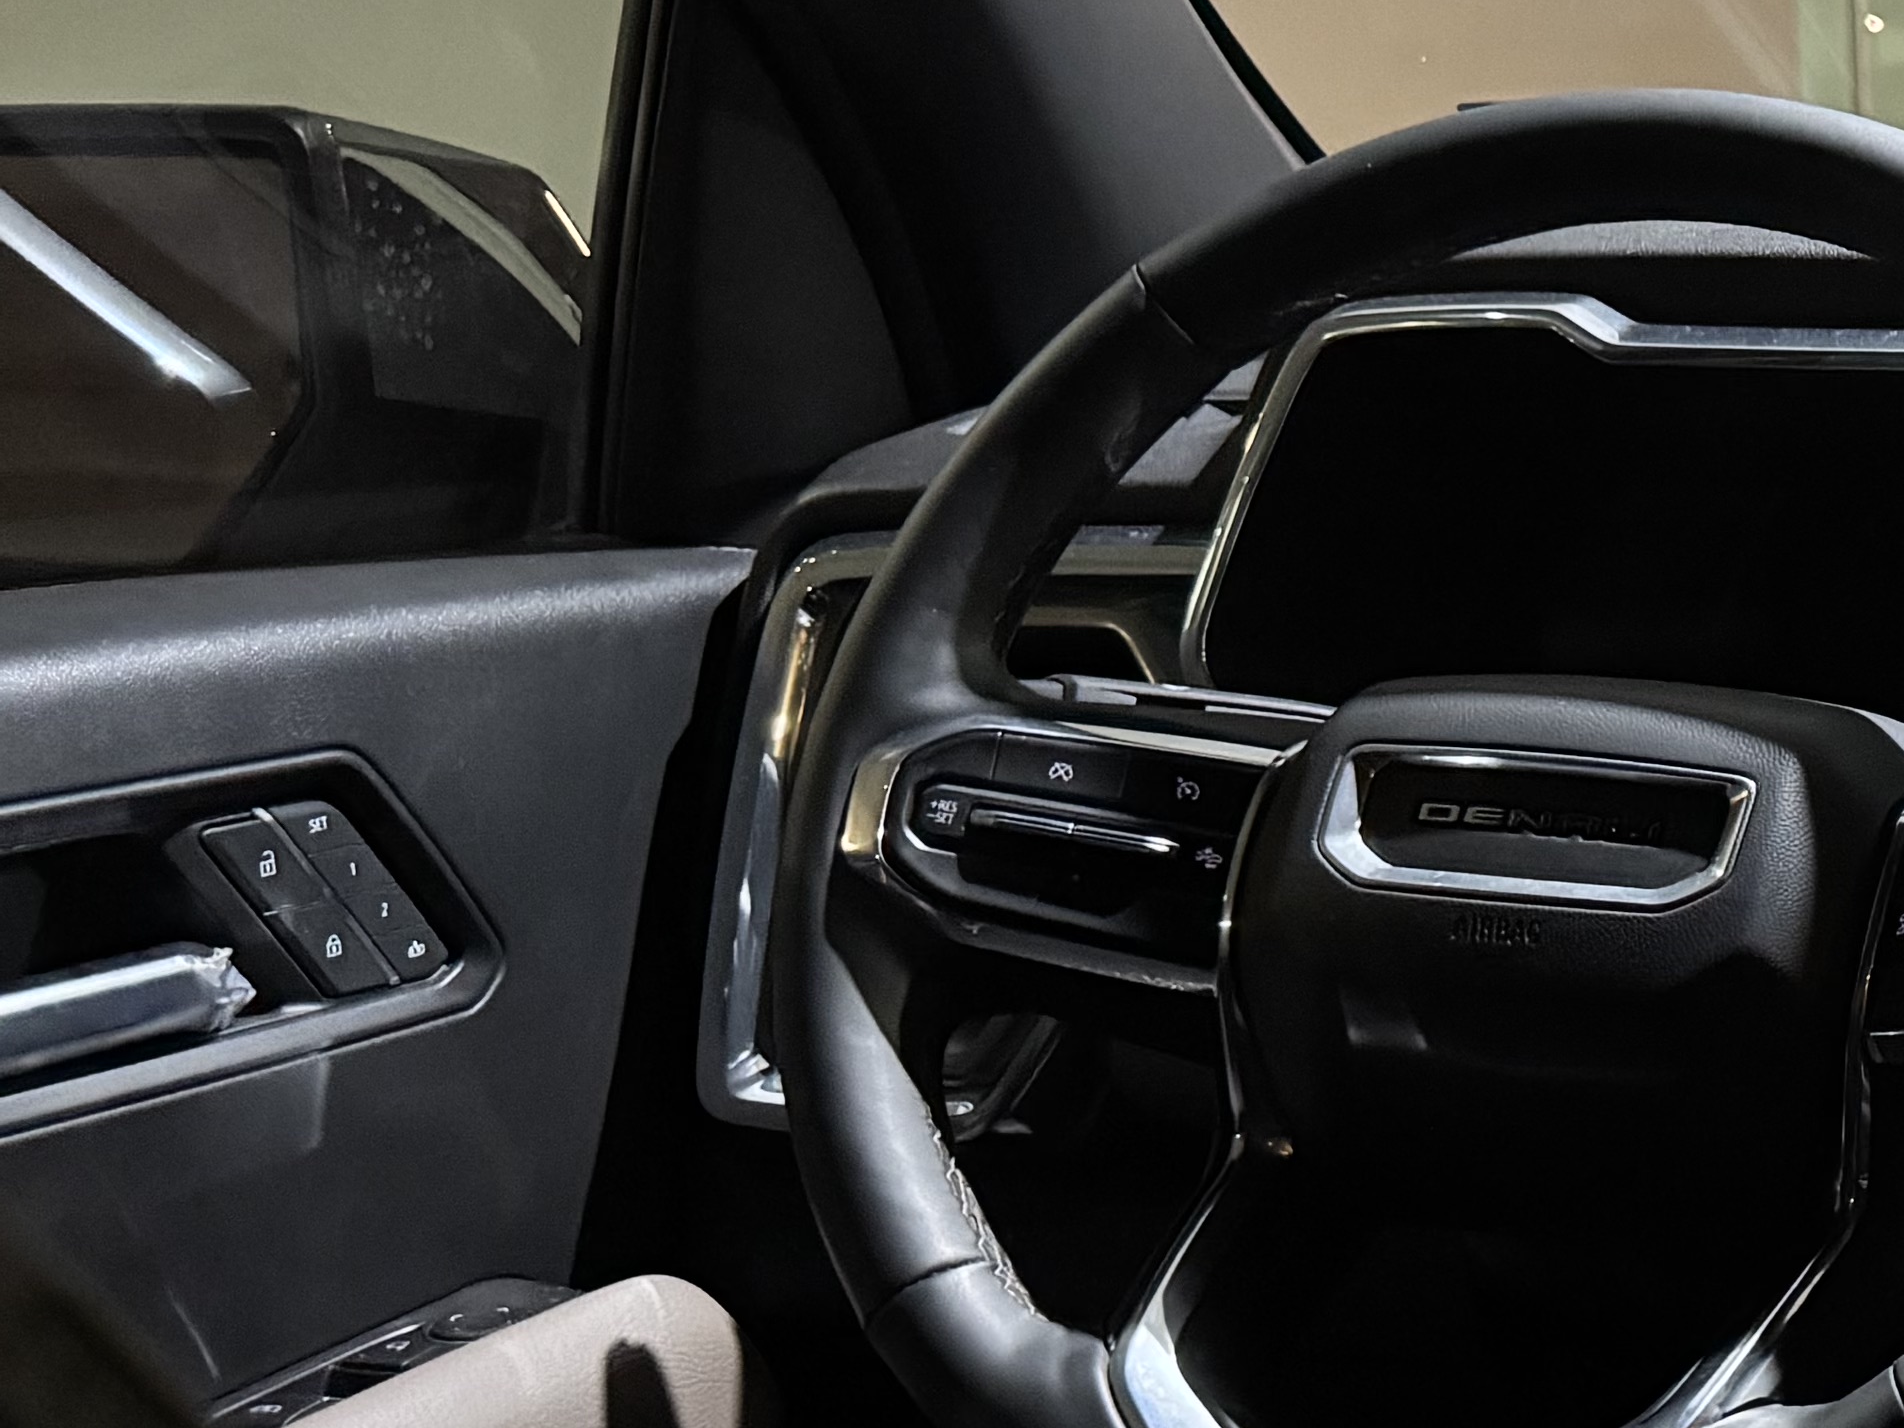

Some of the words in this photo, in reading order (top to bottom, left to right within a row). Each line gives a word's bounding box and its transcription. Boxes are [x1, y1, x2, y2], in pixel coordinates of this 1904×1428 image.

[308, 815, 328, 834] SET
[381, 901, 389, 918] 2
[1449, 913, 1541, 948] AIRBAG
